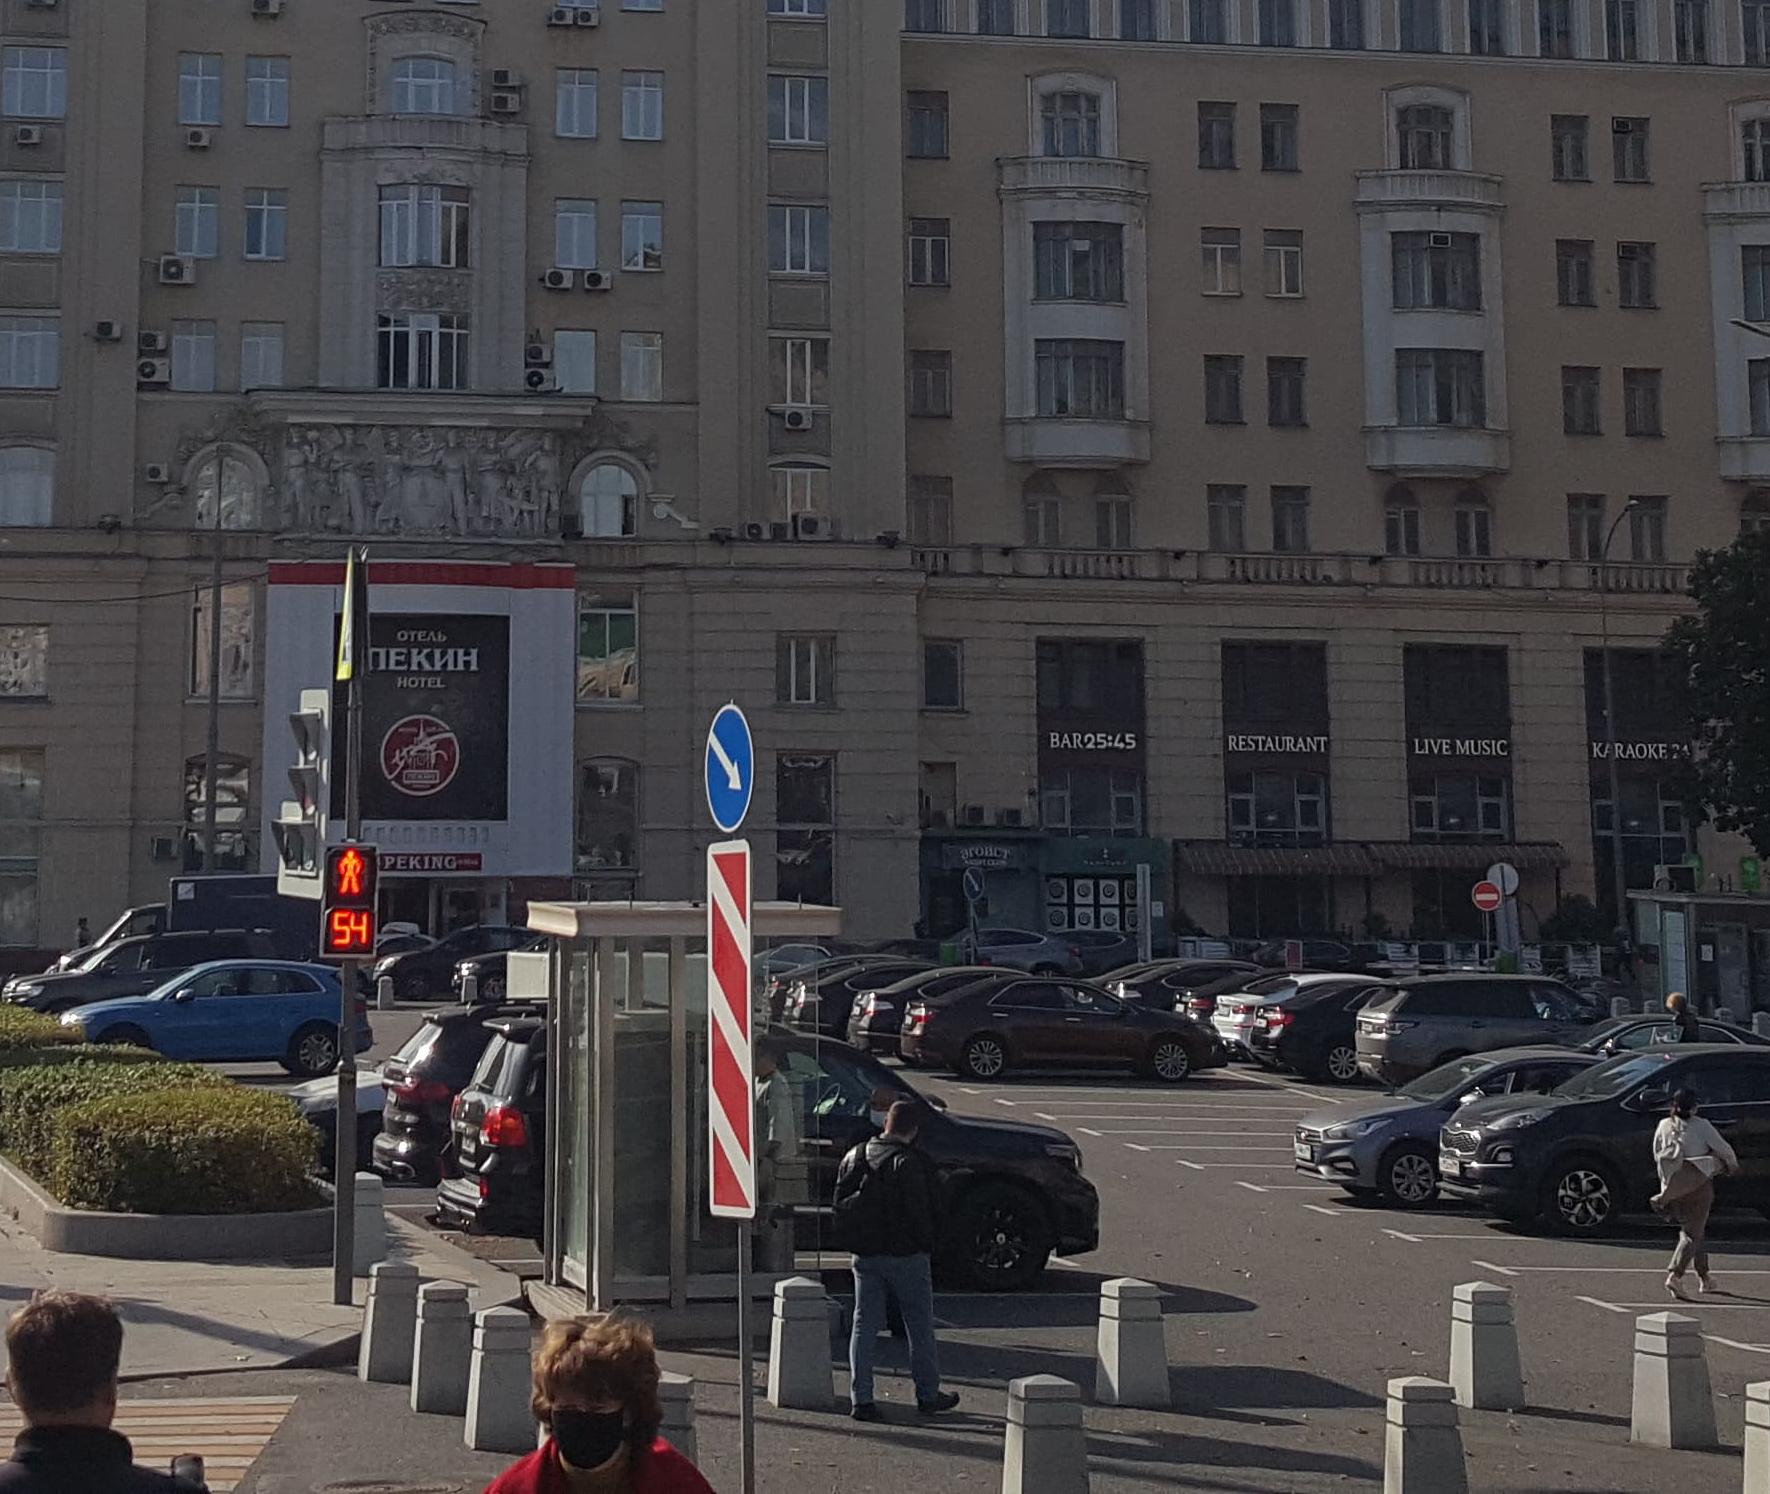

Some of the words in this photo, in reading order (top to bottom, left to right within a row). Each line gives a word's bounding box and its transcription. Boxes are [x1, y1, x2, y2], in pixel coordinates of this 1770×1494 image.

[397, 630, 447, 642] ОТЕЛЬ
[368, 648, 479, 671] ПЕКИН
[397, 677, 446, 688] HOTEL
[1228, 735, 1328, 753] RESTAURANT
[1413, 738, 1451, 755] LIVE
[1455, 740, 1508, 756] MUSIC
[1592, 742, 1667, 760] KARAOKE
[383, 855, 457, 869] PEKING
[333, 911, 369, 946] 54
